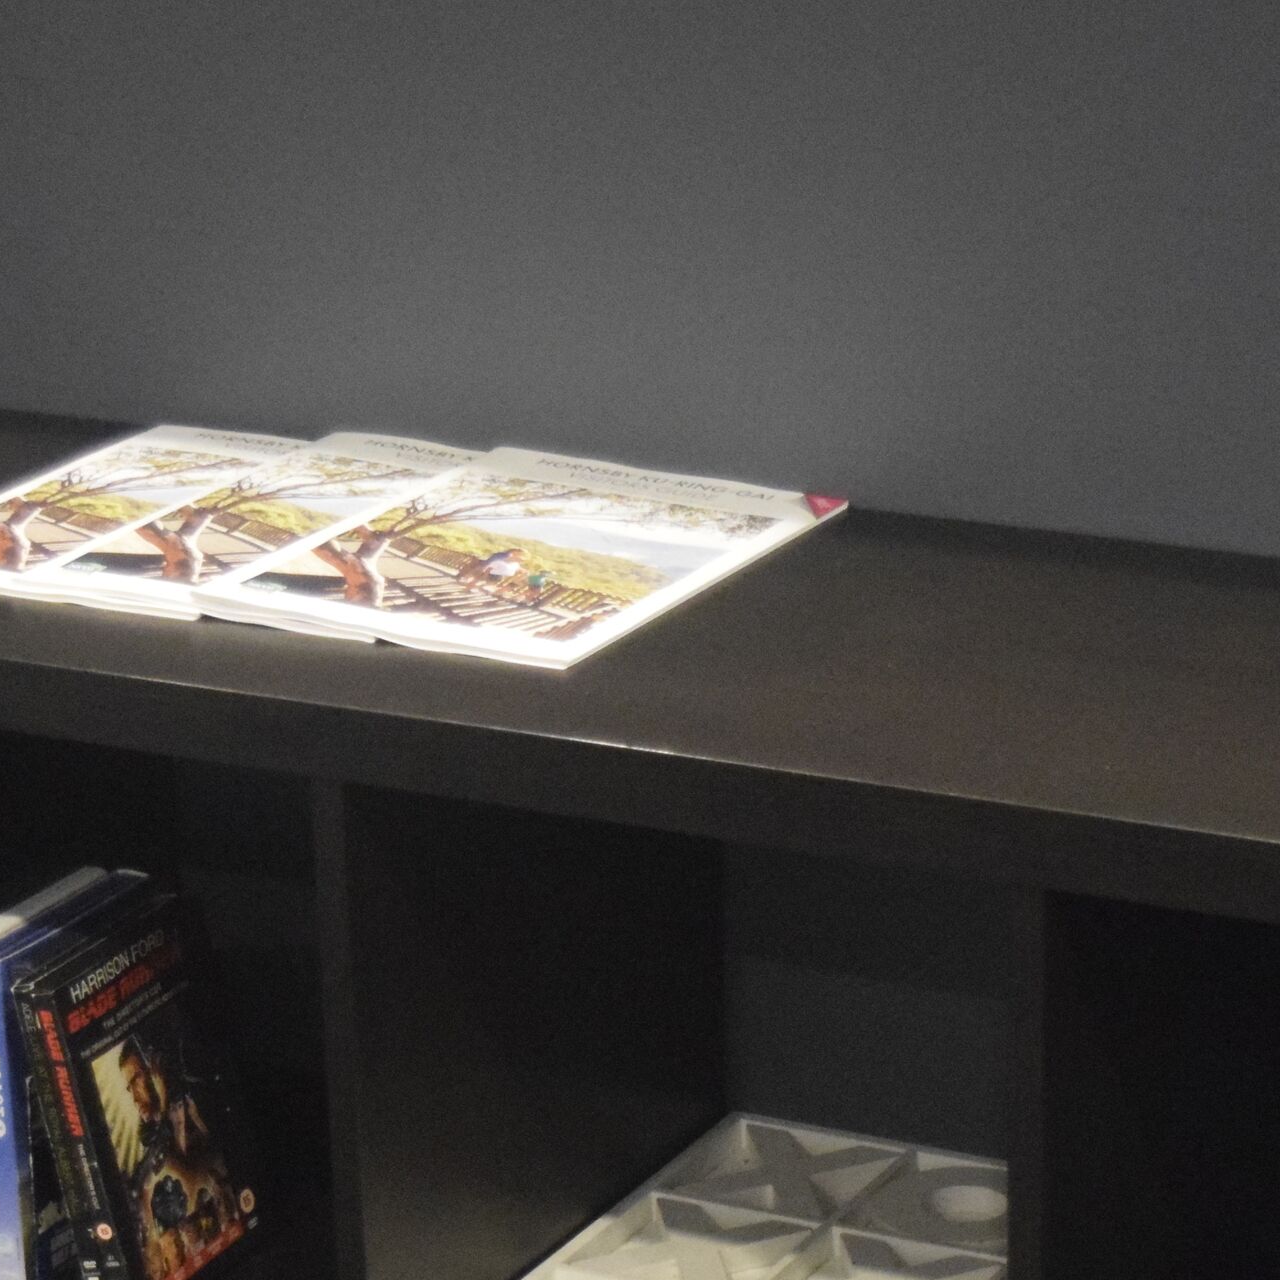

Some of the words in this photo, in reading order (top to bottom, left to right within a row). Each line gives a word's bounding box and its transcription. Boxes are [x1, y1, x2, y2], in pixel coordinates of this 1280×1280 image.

[537, 457, 632, 479] HORNSBY
[71, 950, 131, 1004] HARRISON
[131, 929, 165, 963] FORD
[21, 1002, 37, 1033] ADELE
[37, 1009, 65, 1063] BLADE
[55, 1065, 85, 1137] RUNNER
